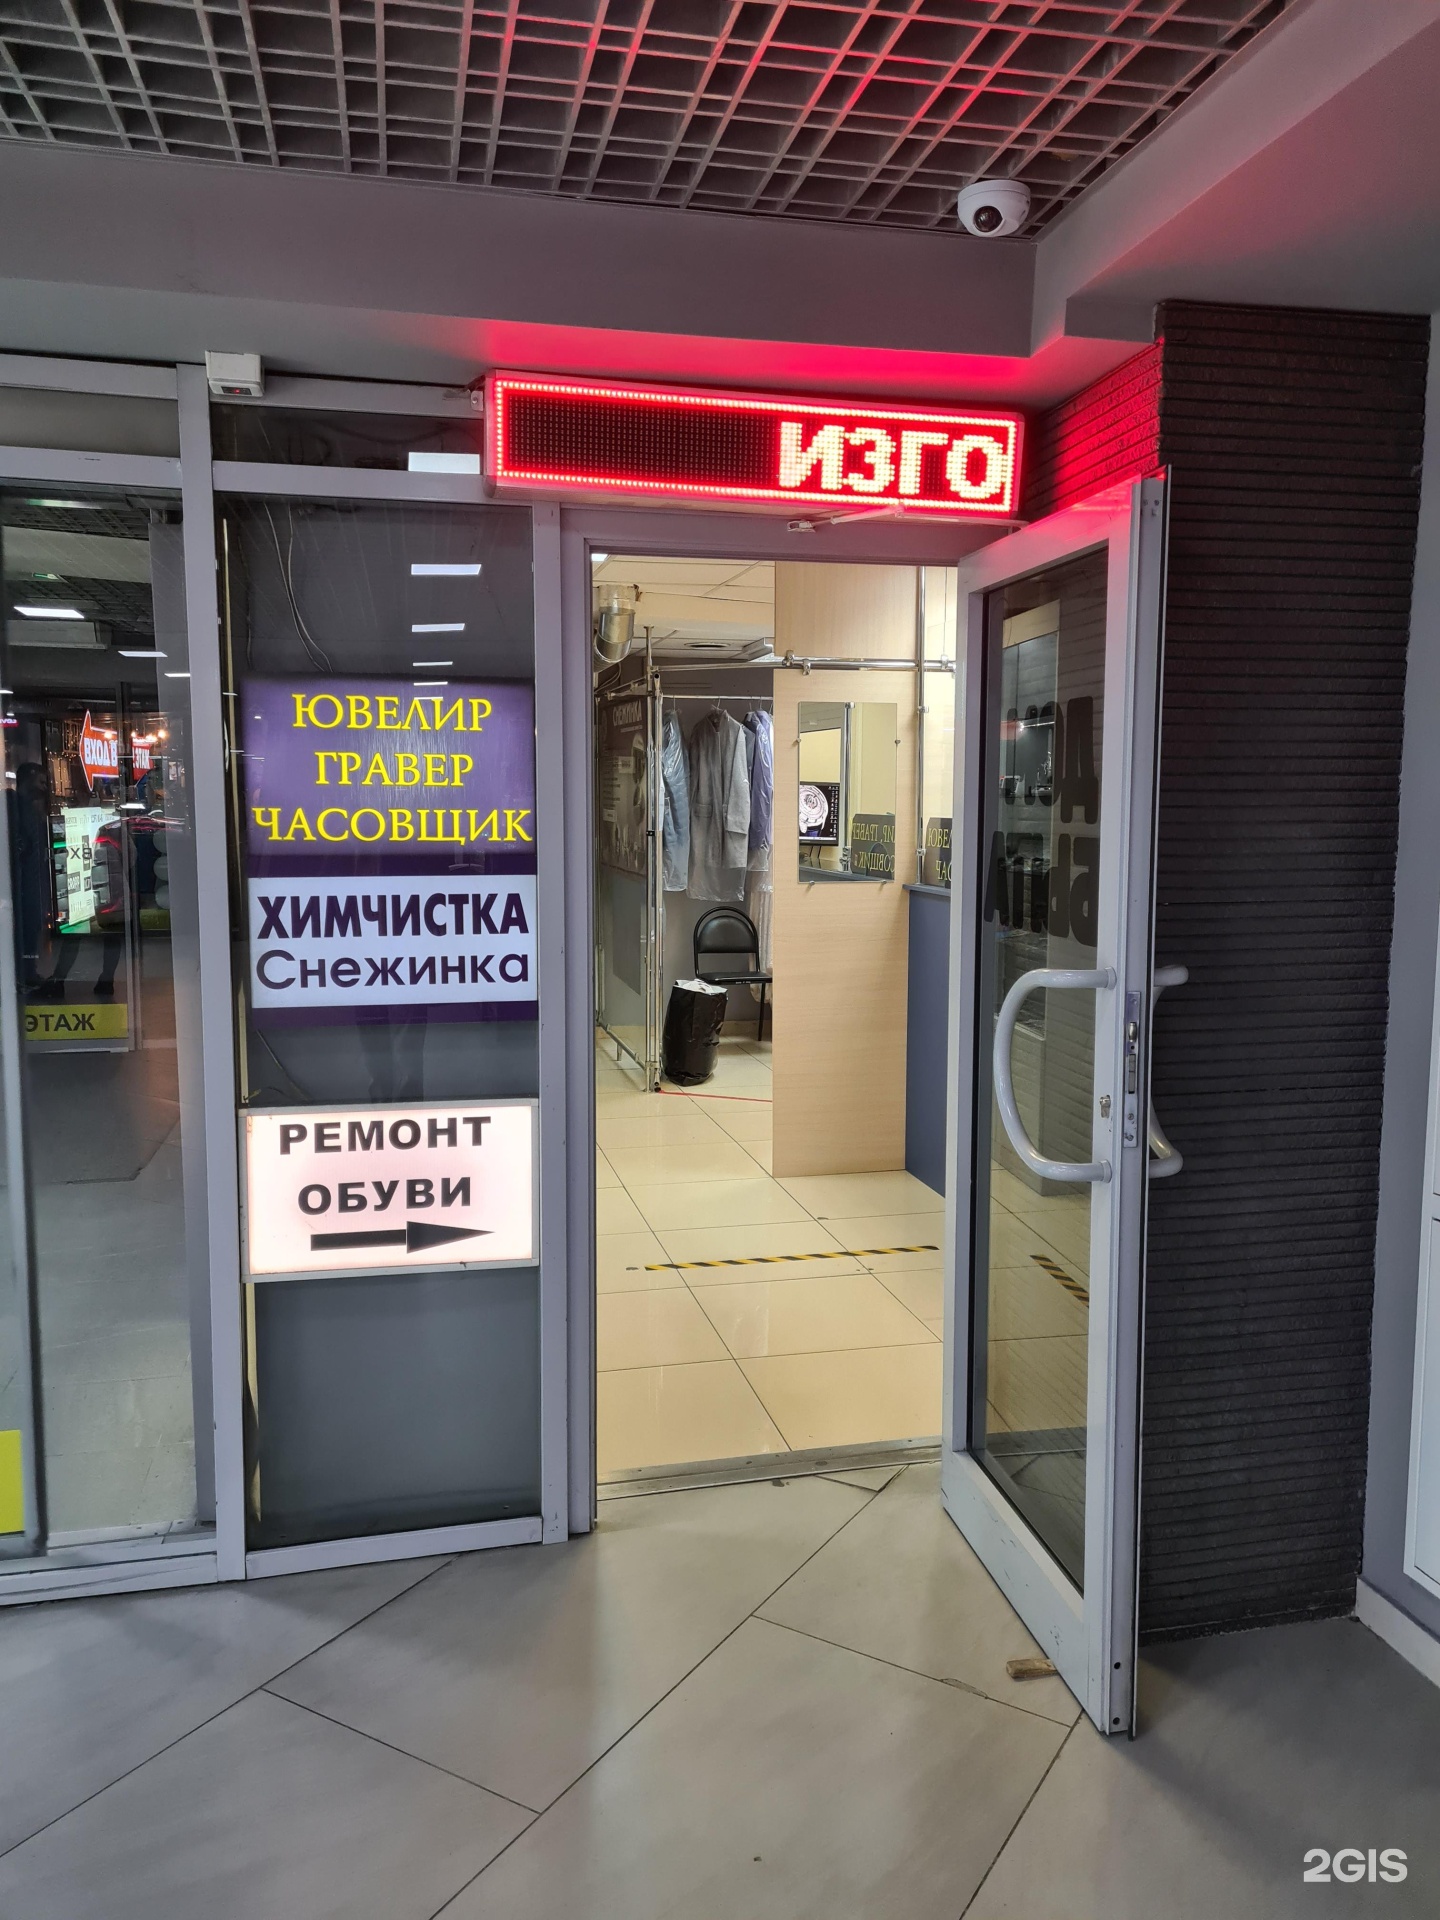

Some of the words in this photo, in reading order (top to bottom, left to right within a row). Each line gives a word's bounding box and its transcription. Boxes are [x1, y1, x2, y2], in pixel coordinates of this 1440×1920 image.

[780, 420, 1005, 499] ИЗГО
[291, 693, 492, 731] ЮВЕЛИР
[84, 738, 111, 766] ВХОД
[314, 751, 474, 787] ГРАВЕР
[252, 807, 533, 846] ЧАСОВЩИК
[257, 892, 530, 940] ХИМЧИСТКА
[256, 949, 529, 990] Снежинка
[25, 1013, 96, 1033] ЭТАЖ
[279, 1116, 491, 1155] РЕМОНТ
[298, 1176, 471, 1215] ОБУВИ
